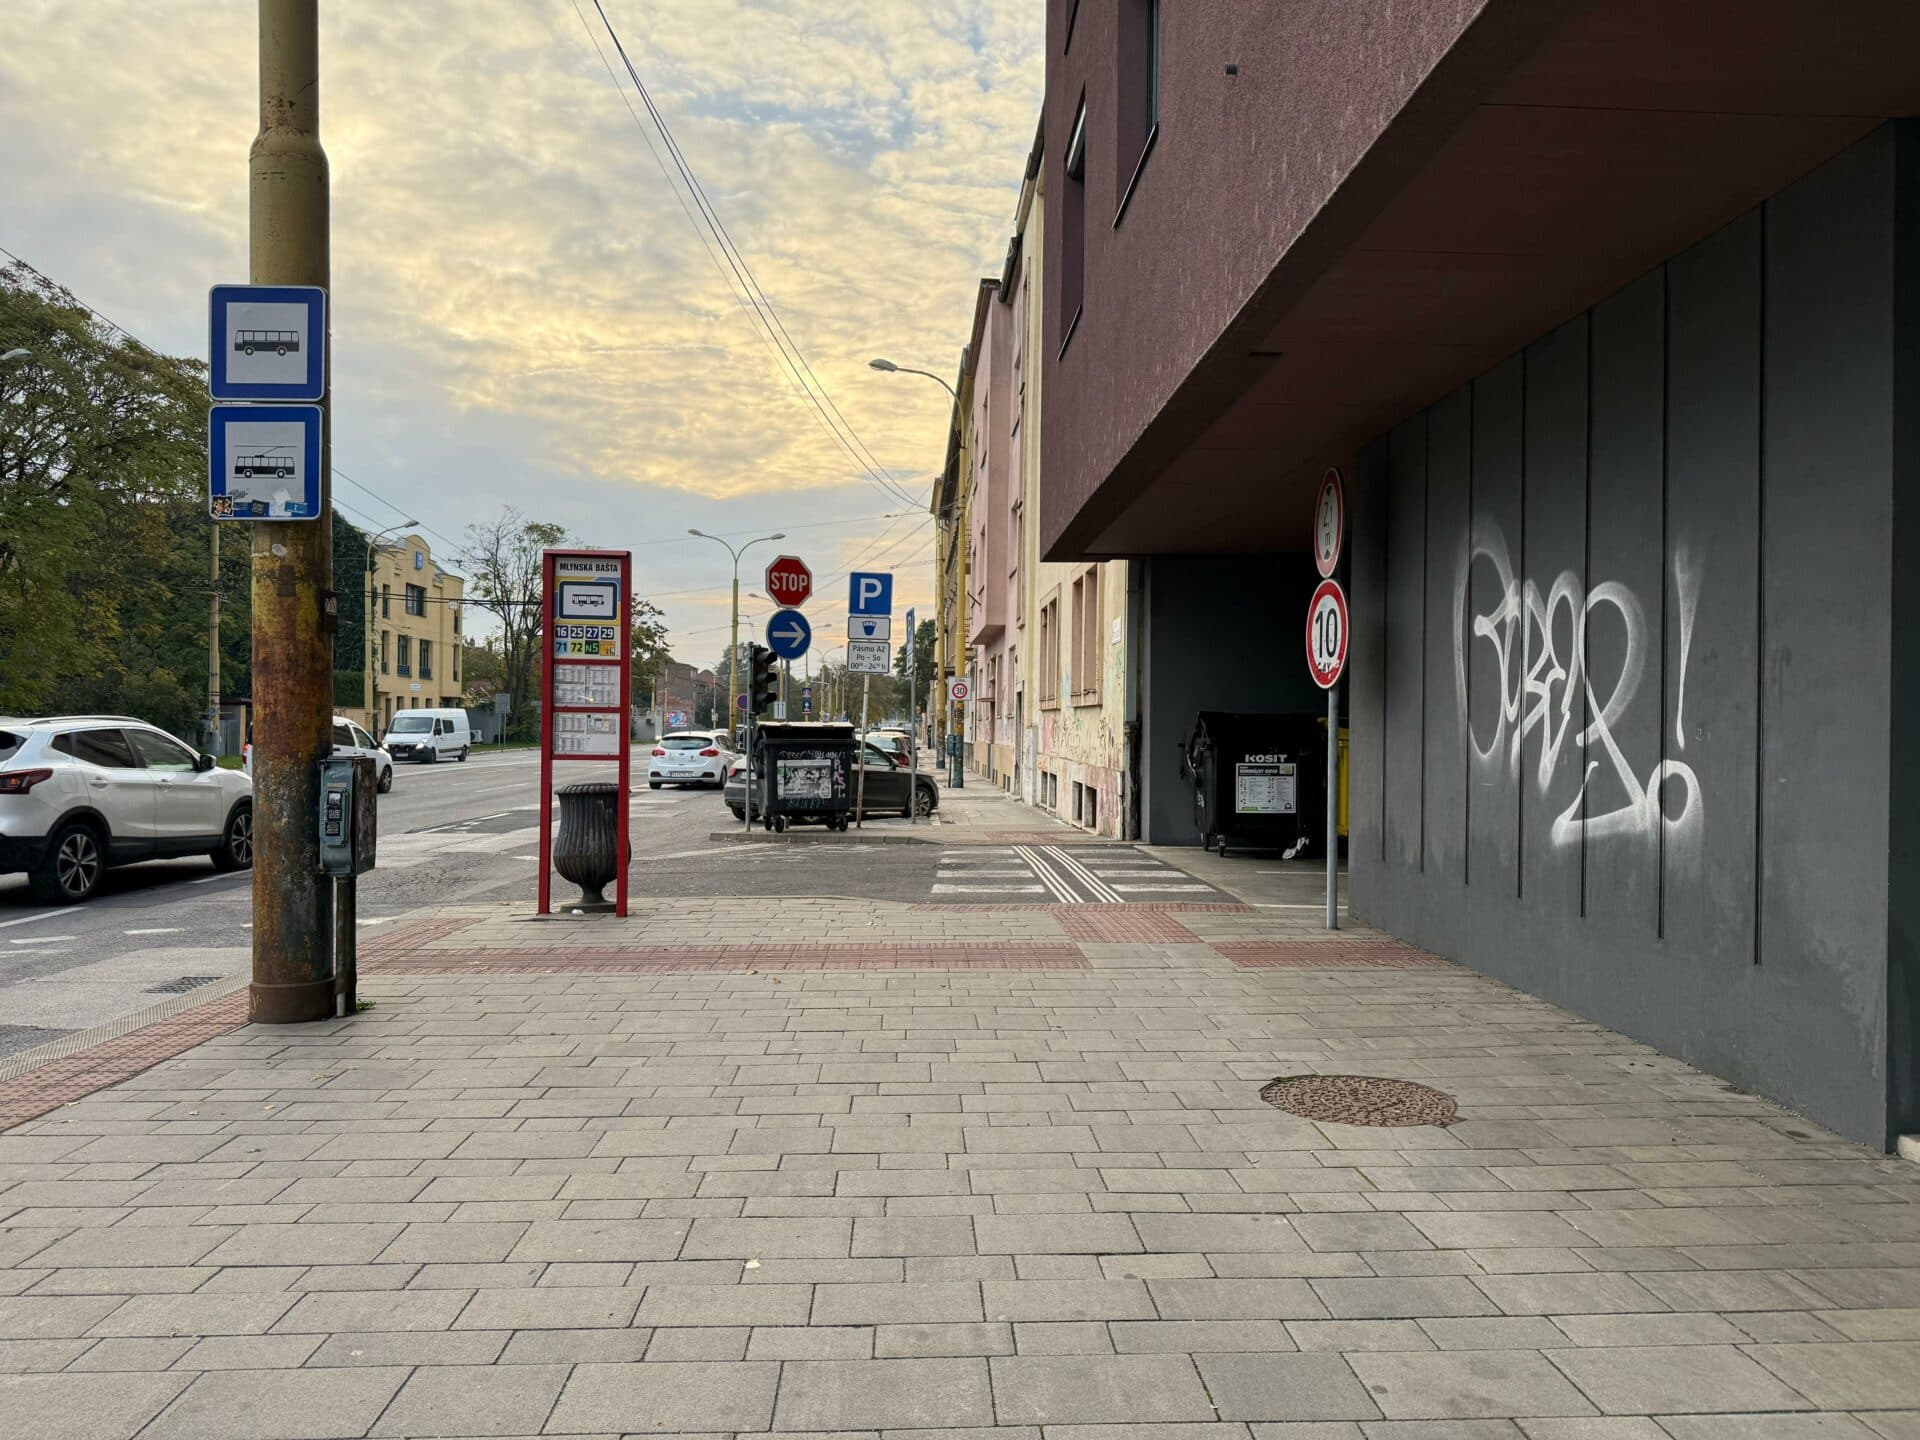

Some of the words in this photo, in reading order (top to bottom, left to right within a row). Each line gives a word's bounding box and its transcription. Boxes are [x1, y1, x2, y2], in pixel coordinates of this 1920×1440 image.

[771, 572, 808, 592] STOP
[859, 578, 882, 610] P
[556, 627, 567, 637] 16
[571, 627, 583, 637] 25
[586, 628, 598, 638] 27
[601, 628, 613, 638] 29
[1315, 607, 1338, 659] 10
[556, 642, 567, 652] 71
[571, 643, 583, 652] 72
[585, 642, 598, 652] N5
[852, 645, 875, 653] Pásmo
[876, 645, 886, 653] A2
[955, 687, 964, 695] 30
[1245, 754, 1288, 763] KOSIT
